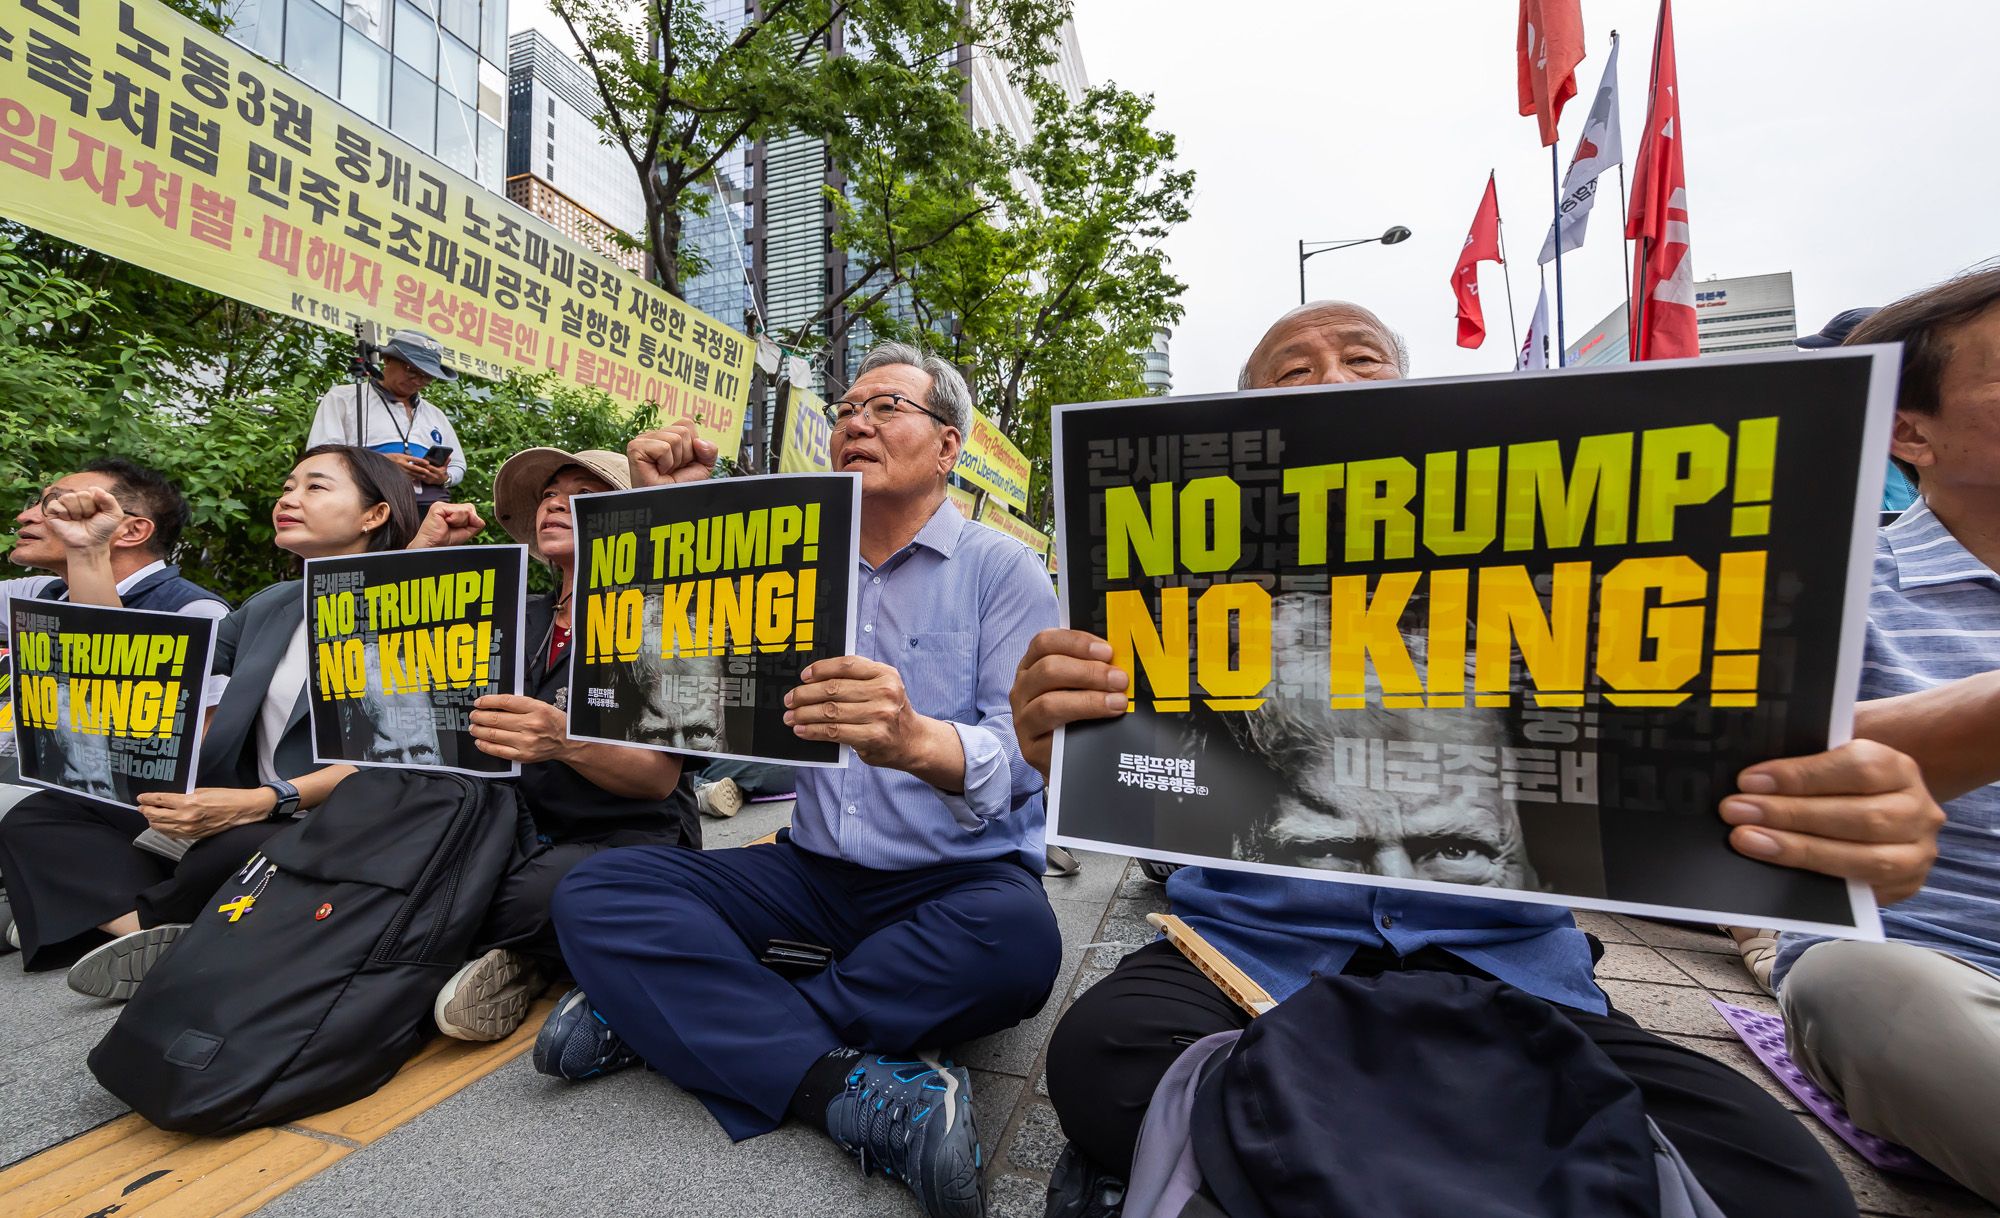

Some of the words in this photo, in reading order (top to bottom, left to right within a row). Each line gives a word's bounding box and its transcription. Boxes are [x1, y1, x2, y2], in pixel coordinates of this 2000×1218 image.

[0, 26, 221, 178] 족처럼
[247, 140, 551, 324] 민주노조파괴공작
[561, 297, 630, 358] 실행한
[637, 333, 710, 392] 통신재벌
[714, 369, 739, 402] KT!
[335, 124, 448, 223] 뭉개고
[462, 195, 622, 311] 노조파괴공작
[628, 286, 686, 343] 자행한
[692, 319, 743, 369] 국정원!
[393, 273, 539, 366] 원상회복엔
[545, 336, 569, 377] 나
[575, 348, 641, 401] 몰라라!
[645, 376, 679, 417] 이게
[971, 419, 992, 455] Killing
[977, 457, 1004, 489] Liberation
[1087, 428, 1286, 486] 관세폭탄
[987, 505, 1003, 523] From
[1002, 516, 1012, 532] the
[1011, 522, 1024, 539] river
[1105, 475, 1241, 580] NO
[1283, 416, 1780, 566] TRUMP!
[590, 531, 637, 589] NO
[650, 503, 821, 580] TRUMP!
[317, 591, 355, 638] NO
[364, 568, 496, 631] TRUMP!
[586, 588, 644, 665] NO
[660, 568, 817, 660] KING!
[1106, 582, 1272, 713] NO
[1330, 550, 1768, 710] KING!
[20, 631, 51, 672] NO
[59, 633, 190, 677] TRUMP!
[318, 638, 367, 702] NO
[378, 620, 492, 696] KING!
[21, 674, 58, 730] NO
[69, 677, 181, 739] KING!
[1117, 752, 1195, 779] 트럼프위협
